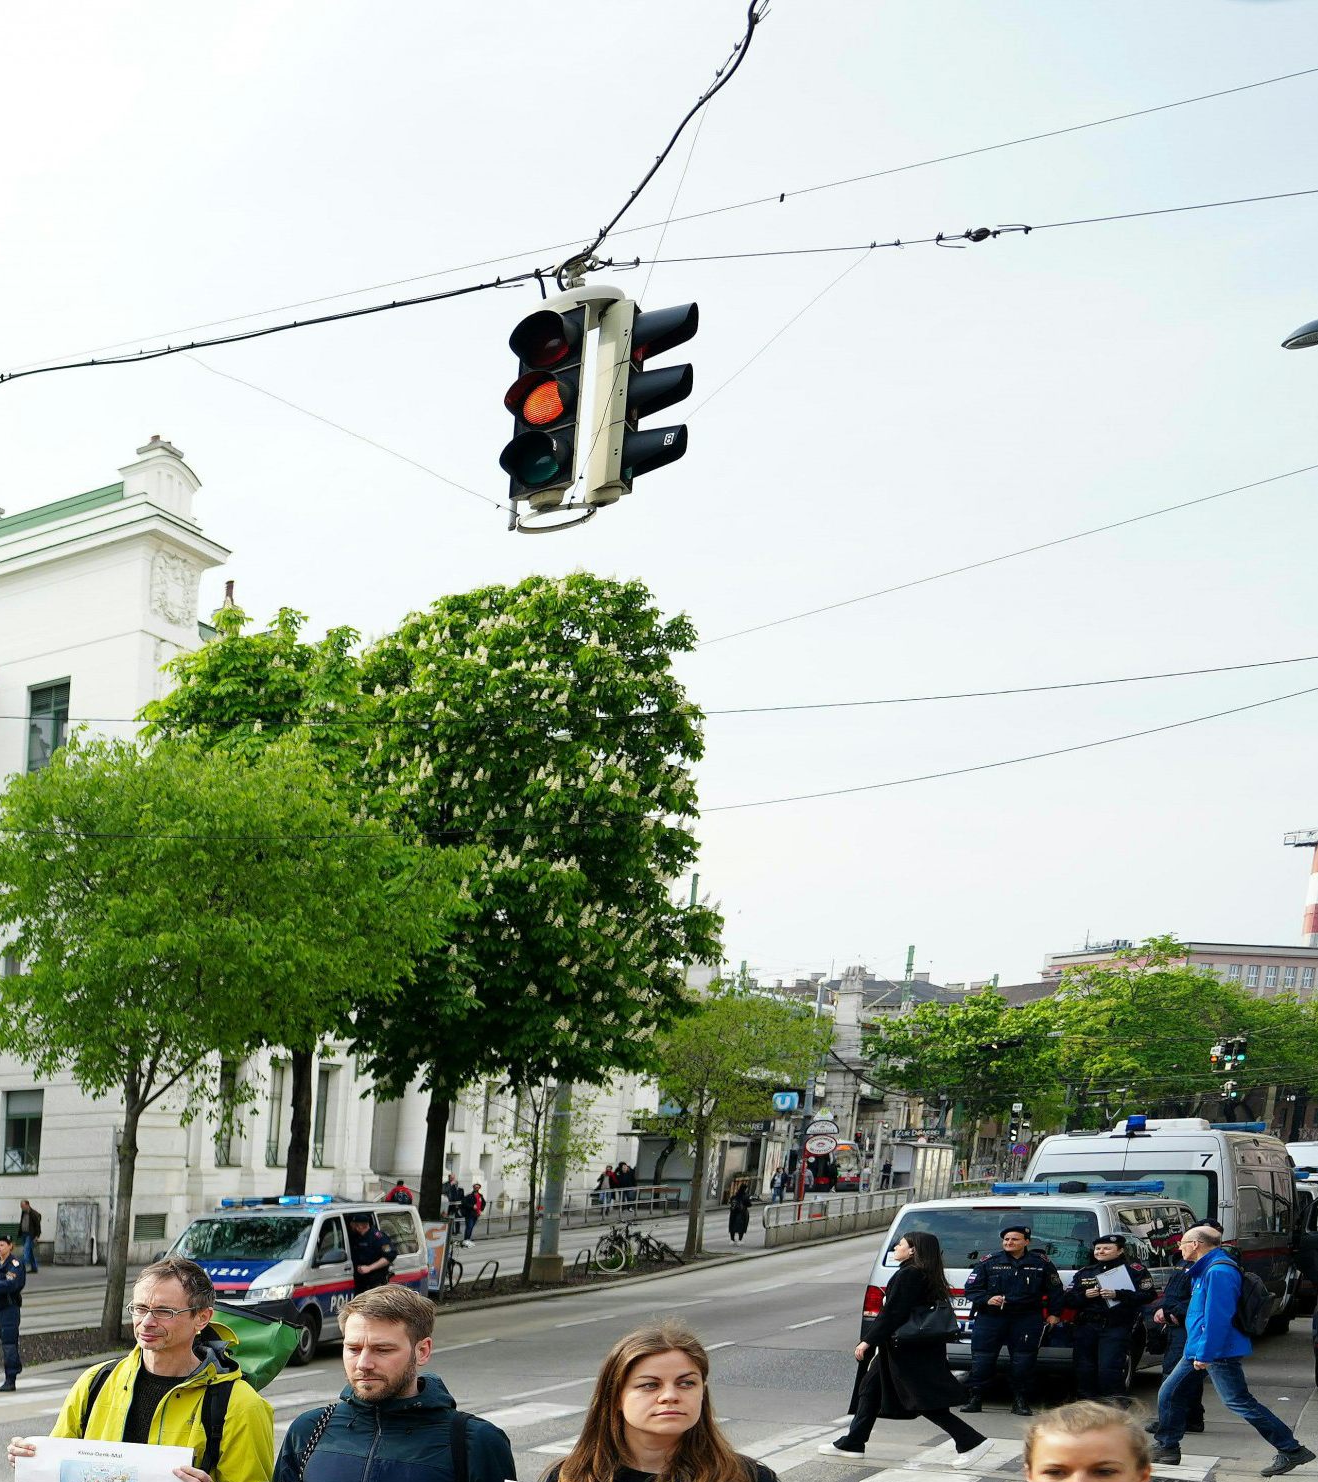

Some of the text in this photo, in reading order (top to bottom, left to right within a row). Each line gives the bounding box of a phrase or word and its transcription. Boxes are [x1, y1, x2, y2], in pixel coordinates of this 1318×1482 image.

[665, 433, 673, 445] 8
[776, 1096, 791, 1109] U
[1200, 1154, 1213, 1167] 7
[78, 1450, 123, 1459] Klima-Denk-Mal
